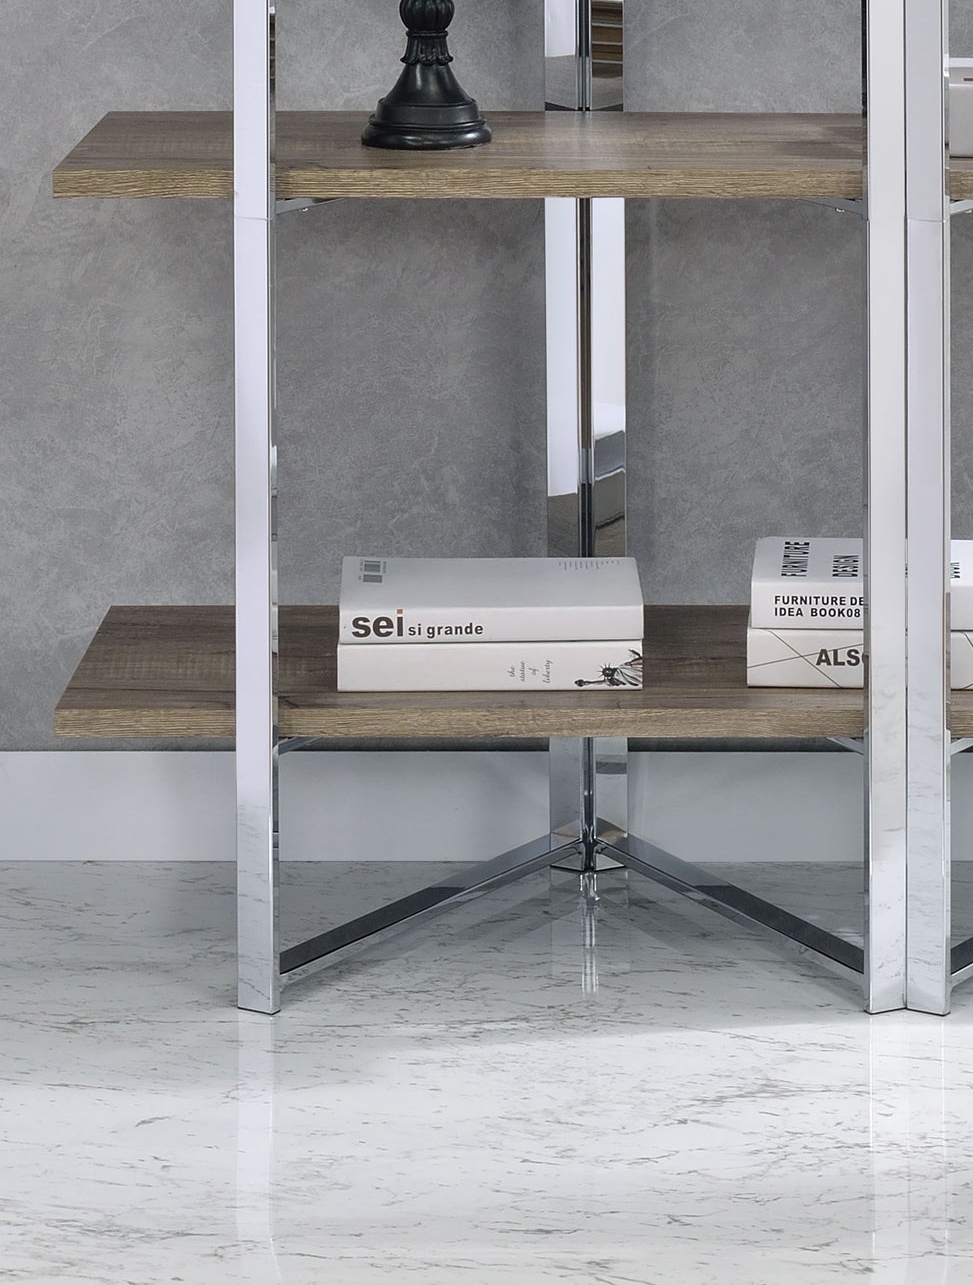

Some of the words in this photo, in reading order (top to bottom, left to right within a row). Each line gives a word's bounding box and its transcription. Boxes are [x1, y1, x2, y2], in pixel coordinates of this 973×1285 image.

[780, 540, 810, 577] FURNITURE
[831, 554, 859, 578] DESIGN
[774, 595, 847, 606] FURNITURE
[774, 607, 804, 617] IDEA
[810, 608, 861, 618] BOOK08
[351, 608, 404, 638] sei
[408, 623, 422, 636] si
[426, 622, 484, 639] grande
[815, 648, 865, 667] ALS
